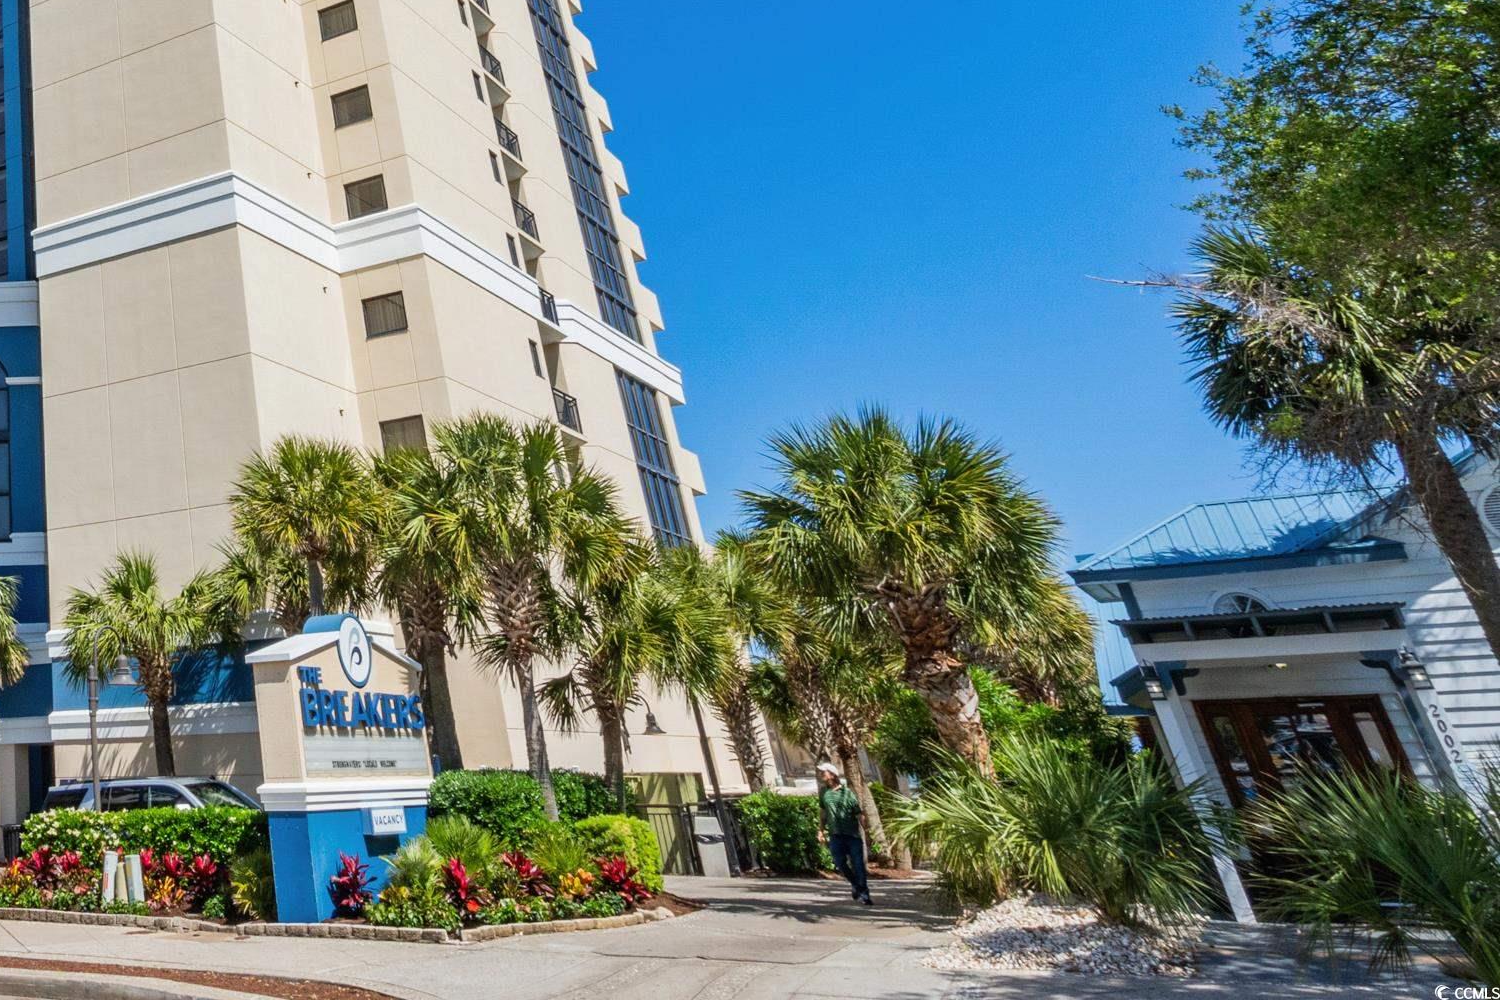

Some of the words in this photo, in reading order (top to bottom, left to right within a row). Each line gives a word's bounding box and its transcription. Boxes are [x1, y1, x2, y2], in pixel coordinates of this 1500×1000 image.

[297, 665, 322, 684] THE
[299, 687, 425, 730] BREAKERS
[1428, 704, 1463, 764] 2002
[374, 814, 404, 825] VACANCY
